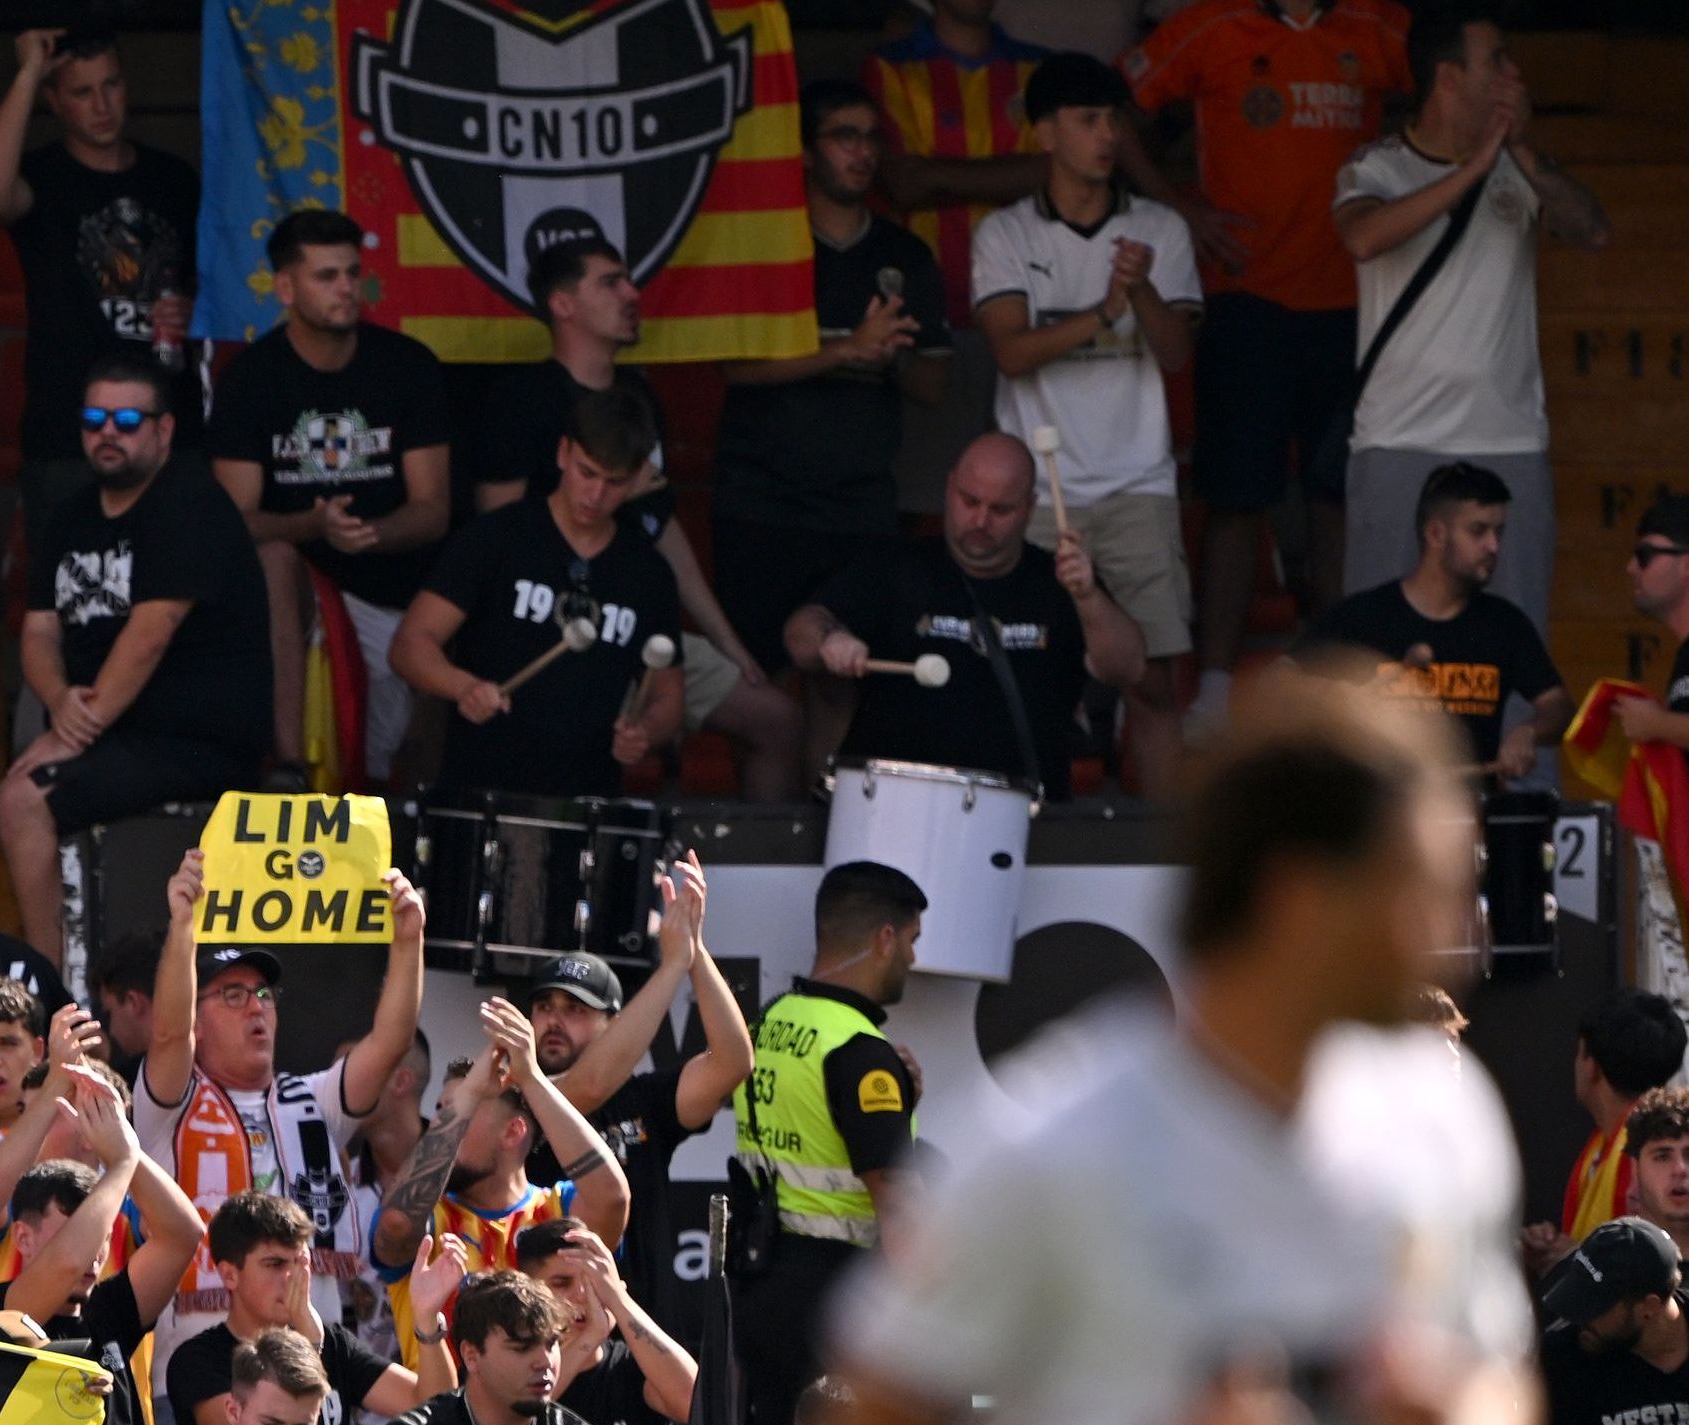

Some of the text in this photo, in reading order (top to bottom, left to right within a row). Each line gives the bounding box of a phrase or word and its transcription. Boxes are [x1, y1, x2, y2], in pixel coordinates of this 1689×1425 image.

[499, 104, 622, 160] CN10
[512, 579, 637, 646] 19 19
[234, 799, 351, 845] LIM
[1559, 825, 1585, 878] 2
[202, 890, 389, 934] HOME
